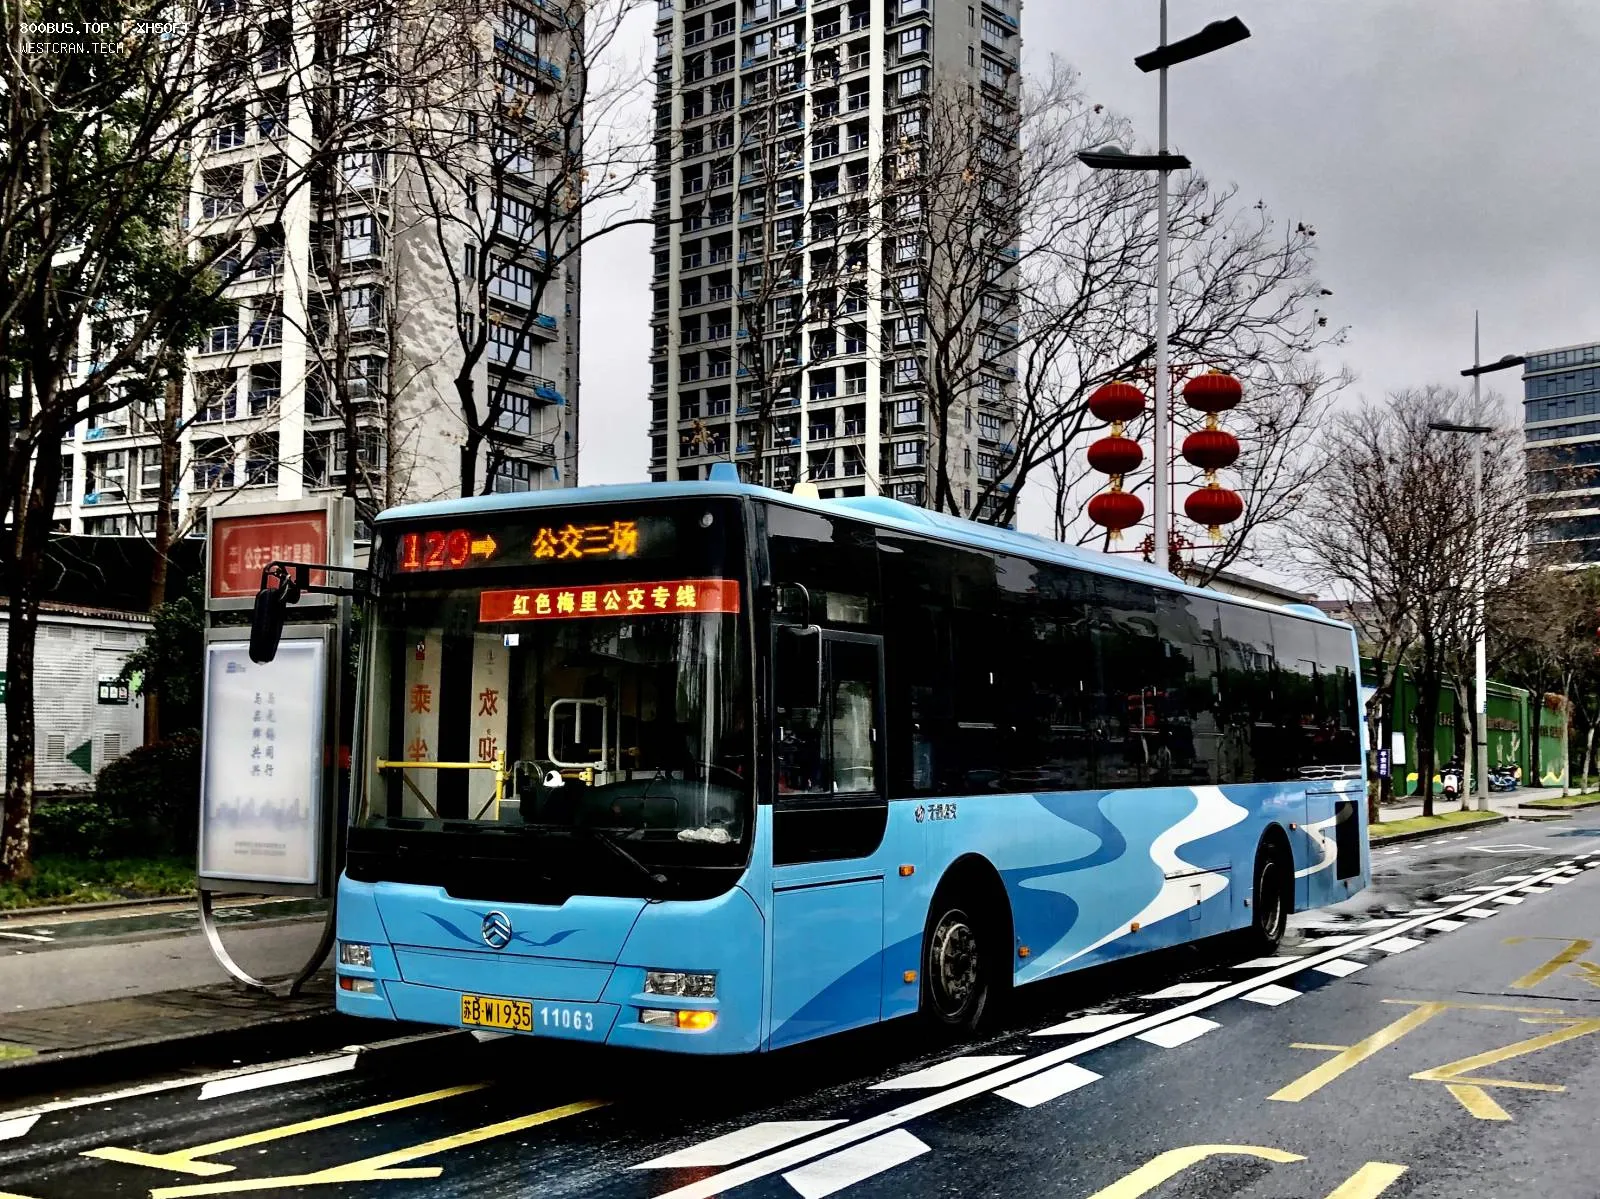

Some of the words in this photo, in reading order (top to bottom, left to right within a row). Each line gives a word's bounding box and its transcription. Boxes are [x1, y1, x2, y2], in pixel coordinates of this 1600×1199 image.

[533, 520, 639, 559] 公交三场
[512, 584, 697, 616] 红色梅里公交专线
[540, 1006, 594, 1031] 11063
